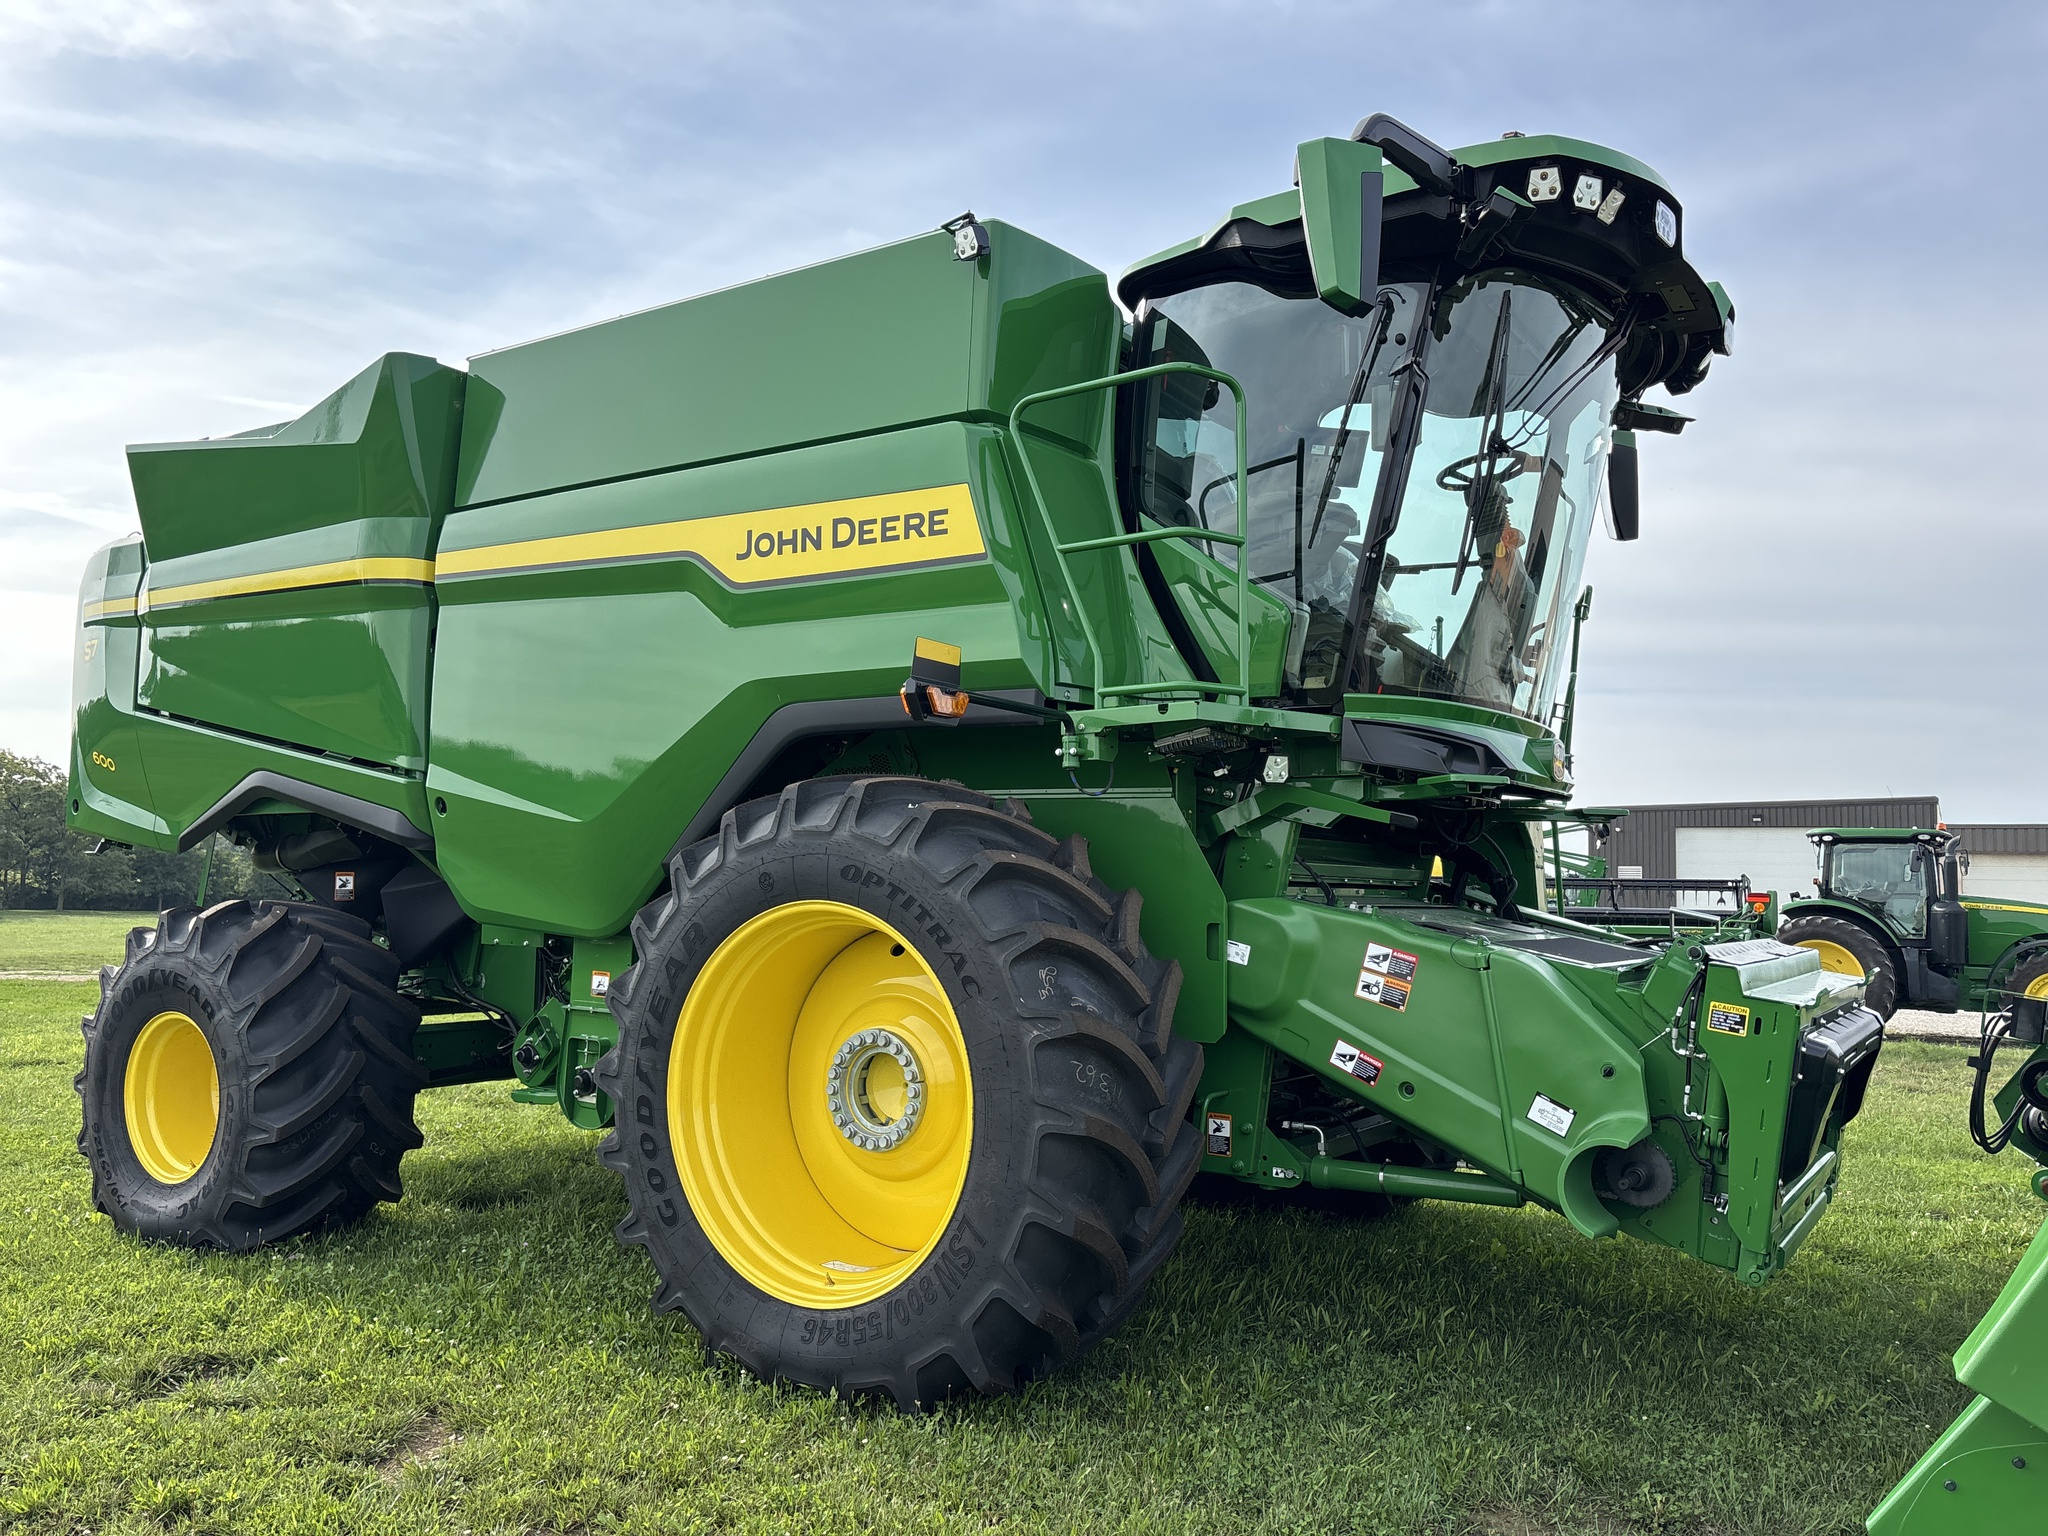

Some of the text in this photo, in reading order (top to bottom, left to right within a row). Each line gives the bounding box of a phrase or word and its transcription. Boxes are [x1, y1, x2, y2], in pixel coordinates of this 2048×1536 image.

[83, 637, 98, 662] S7
[92, 750, 116, 772] 600
[840, 864, 983, 998] OPTITRAC
[1717, 1003, 1748, 1015] CAUTION
[636, 921, 707, 1227] GOODYEAR
